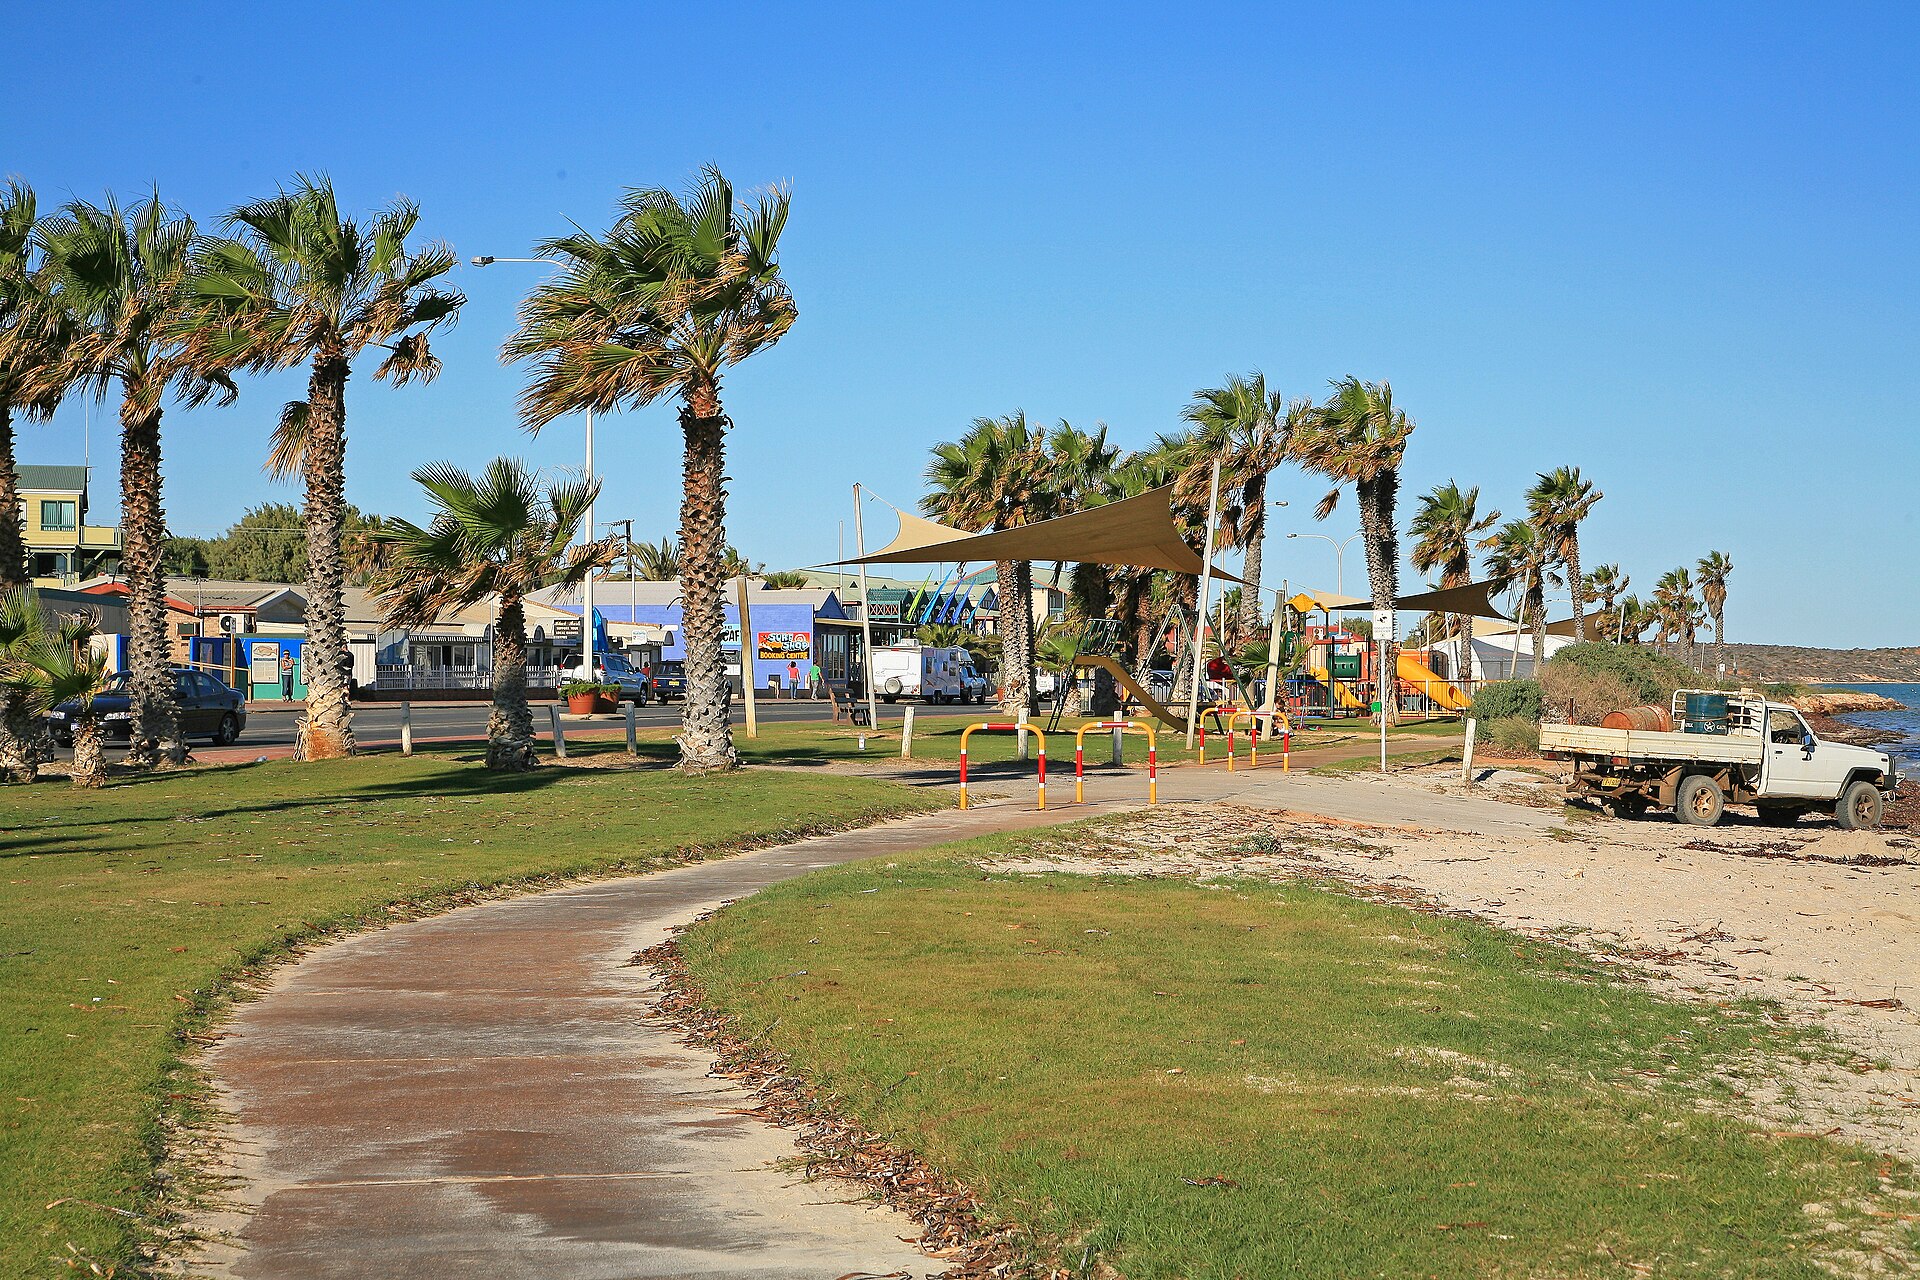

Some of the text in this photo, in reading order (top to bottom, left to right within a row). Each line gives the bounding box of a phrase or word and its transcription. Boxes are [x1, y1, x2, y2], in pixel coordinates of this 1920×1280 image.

[721, 630, 742, 642] CAF
[768, 633, 793, 642] SURF
[781, 641, 810, 651] SHOP
[760, 651, 808, 659] BOOKING CENTRE
